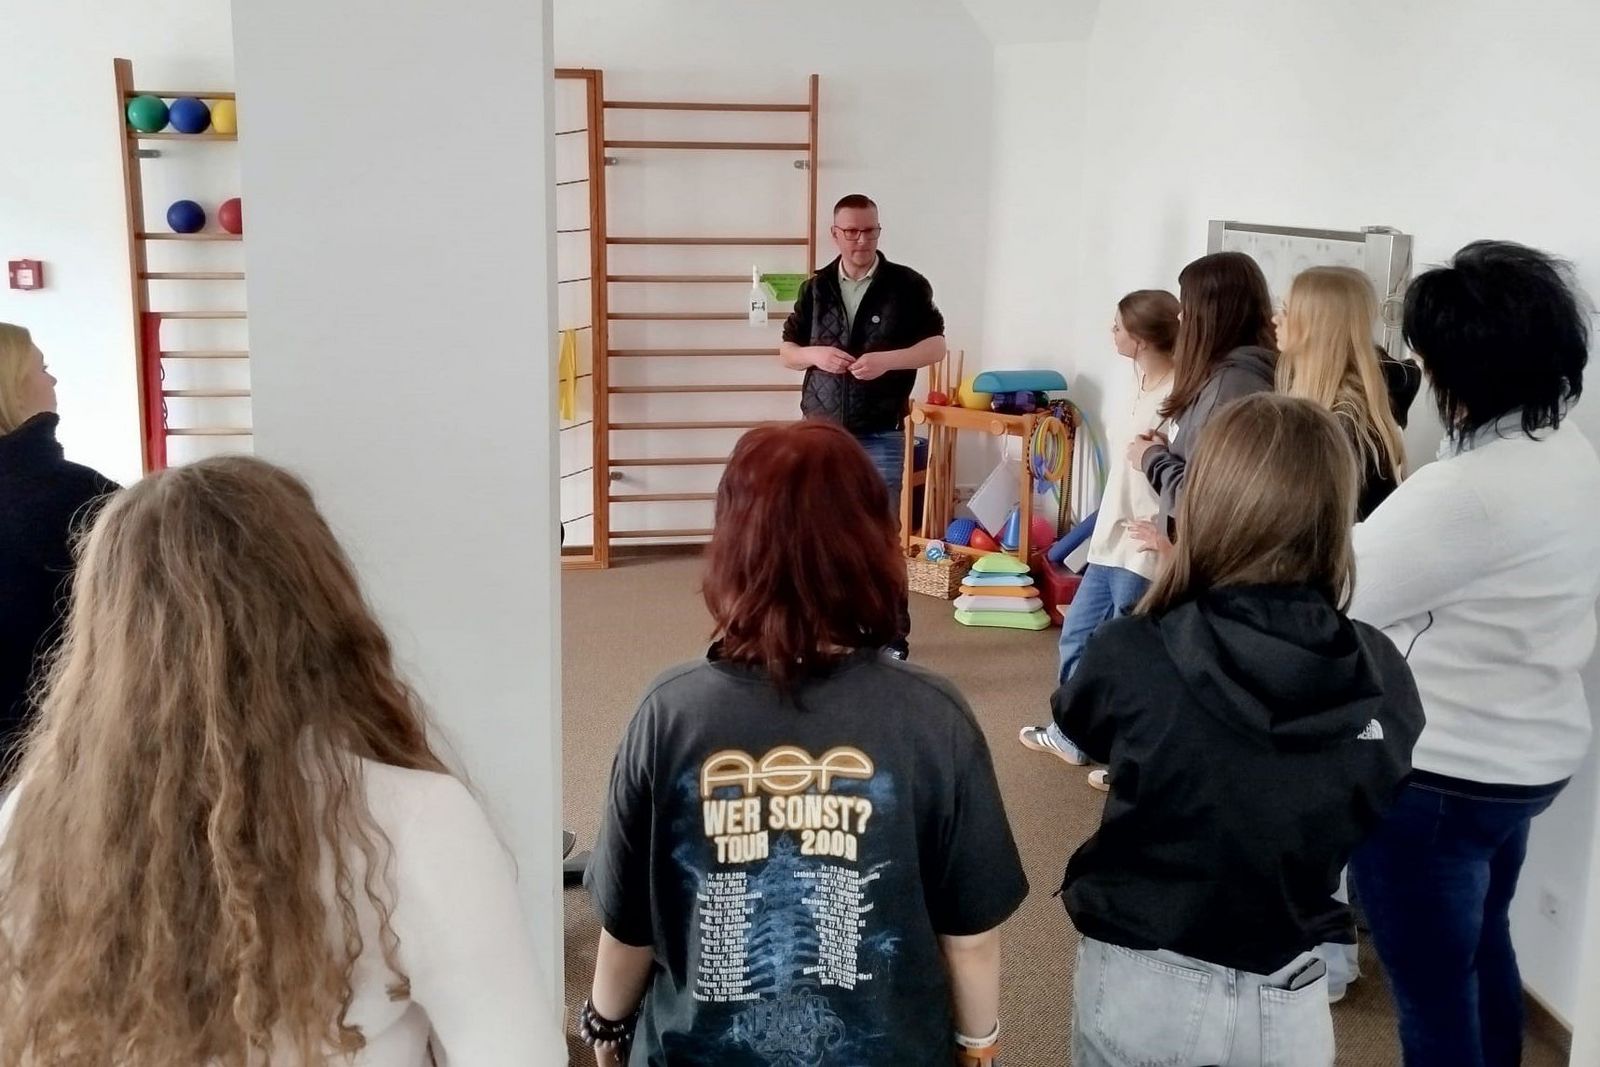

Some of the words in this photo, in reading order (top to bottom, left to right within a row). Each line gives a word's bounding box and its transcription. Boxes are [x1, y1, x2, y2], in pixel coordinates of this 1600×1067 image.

[703, 797, 761, 837] WER
[769, 794, 874, 833] SONST?
[714, 830, 769, 864] TOUR
